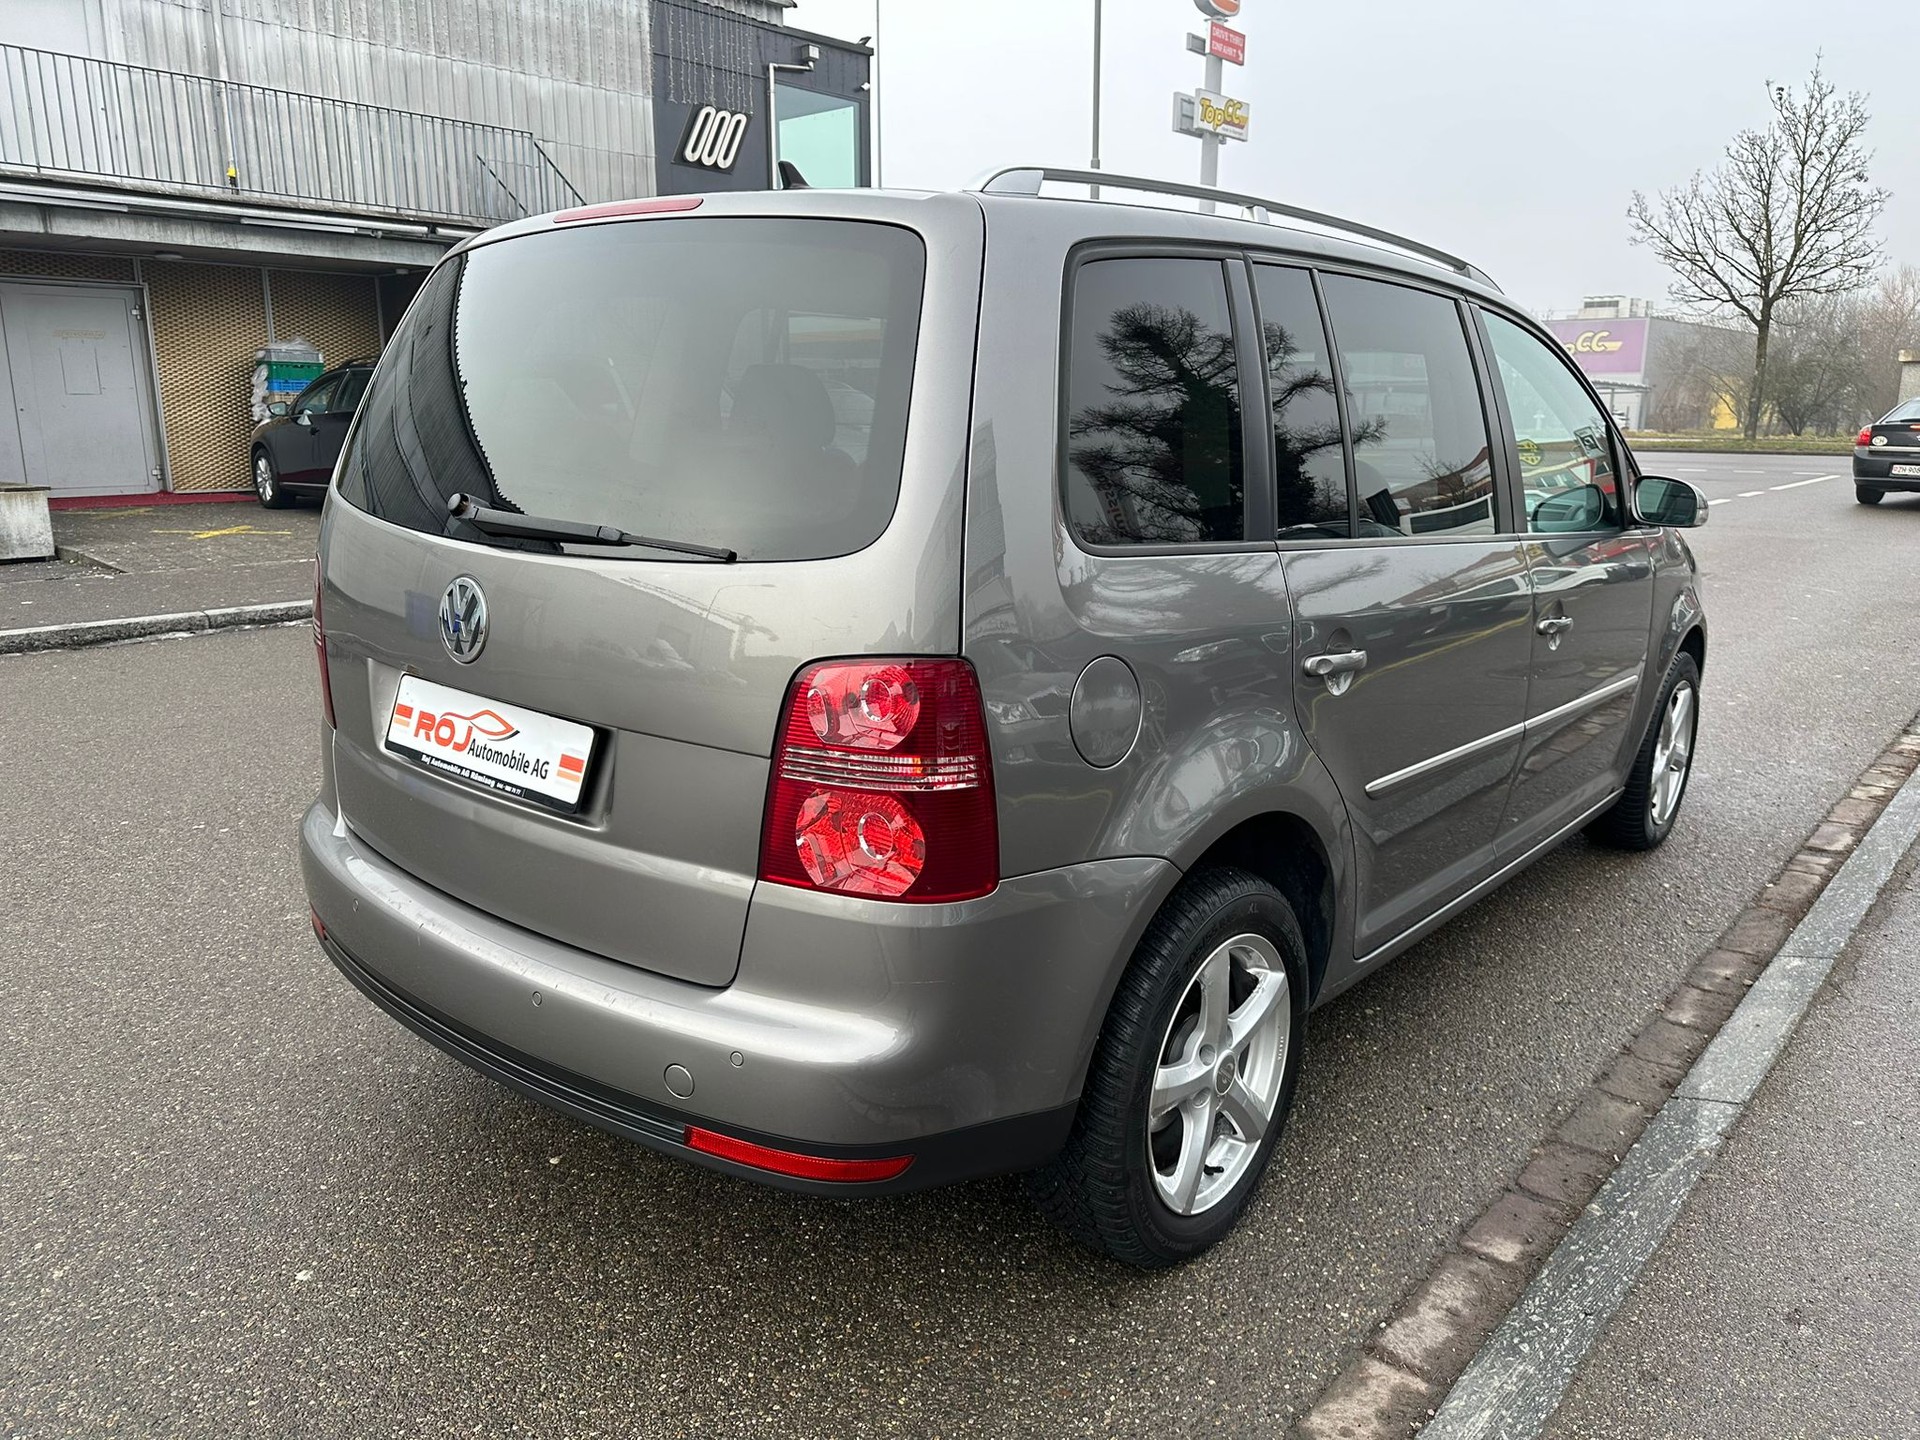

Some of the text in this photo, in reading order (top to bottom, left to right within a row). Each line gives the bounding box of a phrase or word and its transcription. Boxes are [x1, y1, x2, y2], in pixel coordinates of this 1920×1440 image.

[1199, 97, 1243, 131] TopCC
[413, 710, 473, 752] ROJ
[430, 757, 461, 775] Automobile
[467, 738, 550, 779] Automobile AG
